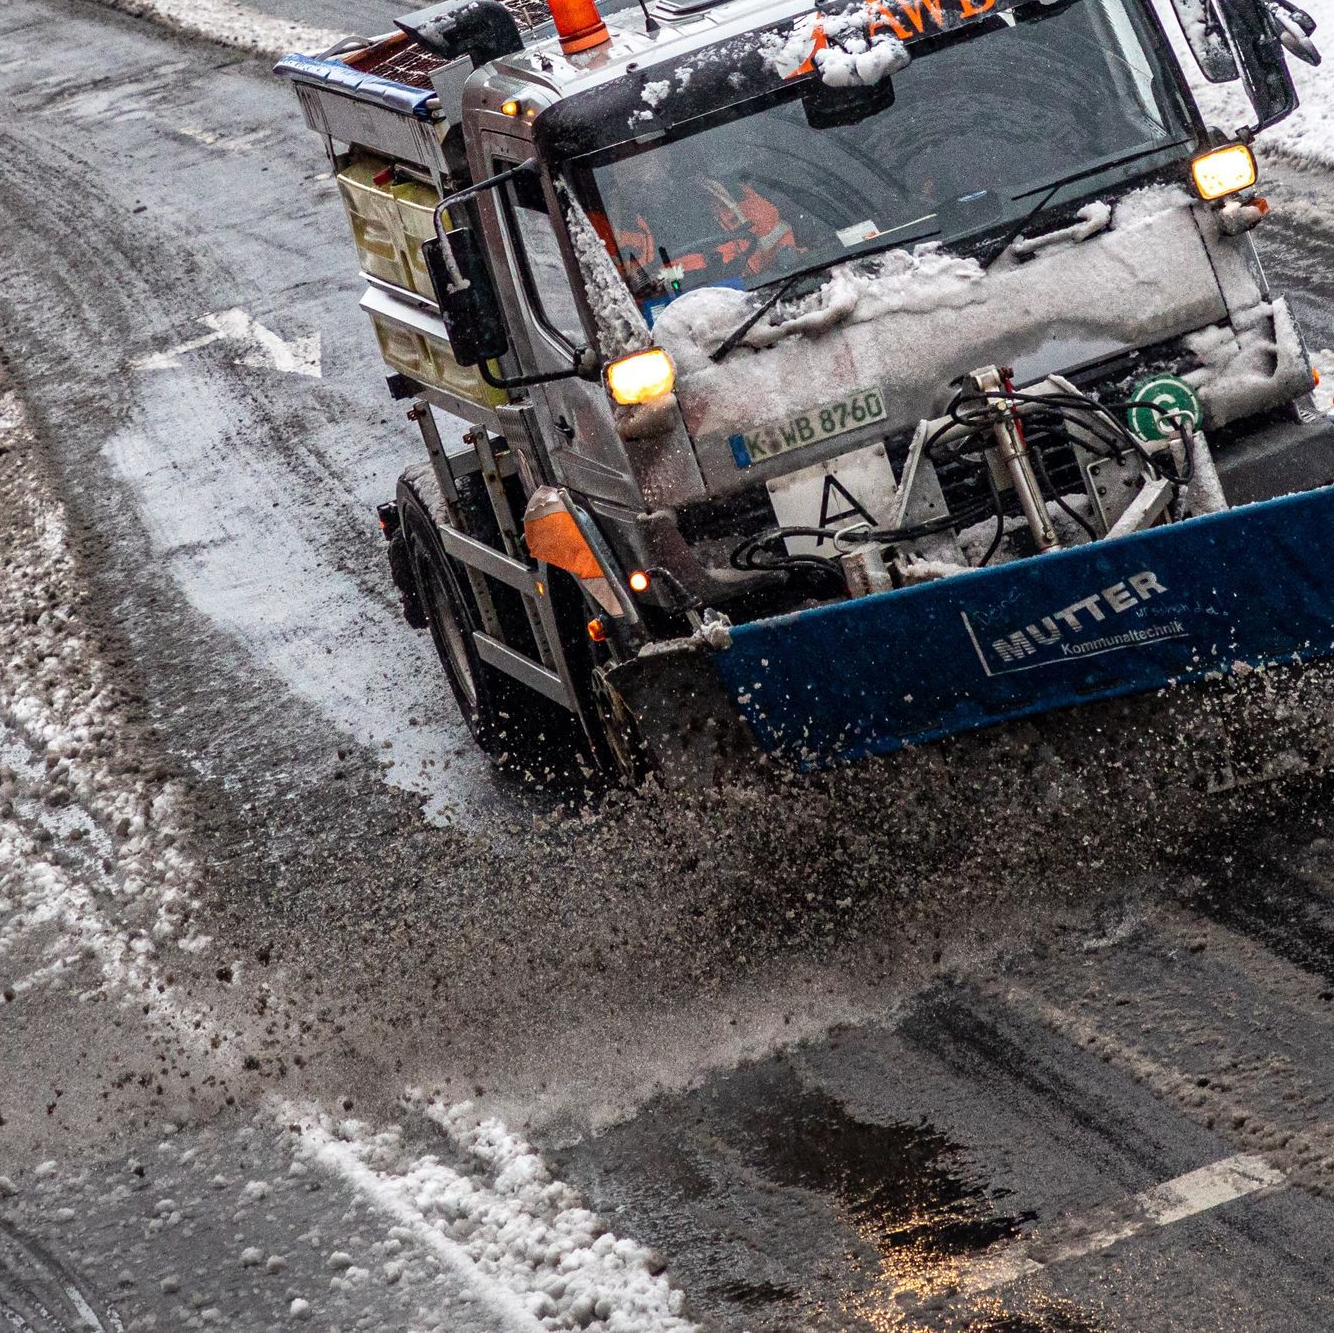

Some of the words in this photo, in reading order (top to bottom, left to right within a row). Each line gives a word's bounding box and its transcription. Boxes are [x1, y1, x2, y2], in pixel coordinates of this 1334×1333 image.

[746, 432, 766, 458] K
[778, 416, 815, 447] WB
[819, 393, 883, 434] 8760
[817, 473, 879, 547] A
[991, 570, 1168, 663] MUTTER
[1061, 620, 1184, 656] Kommunaltechnik
